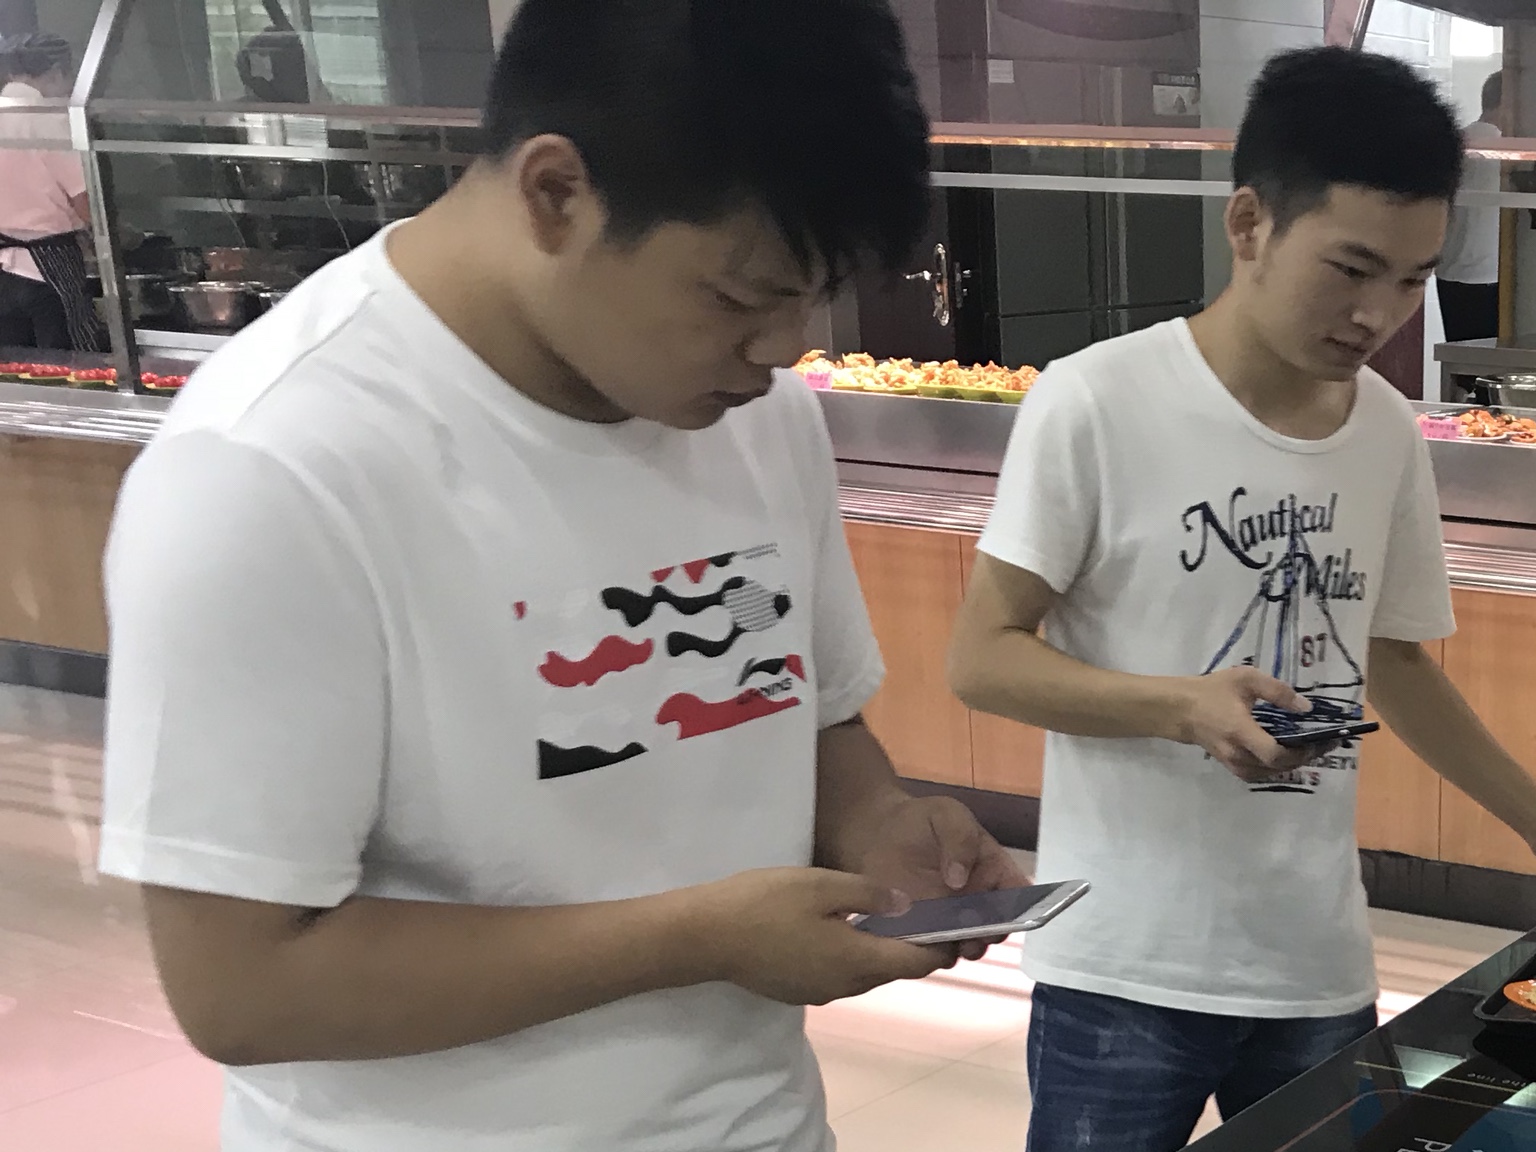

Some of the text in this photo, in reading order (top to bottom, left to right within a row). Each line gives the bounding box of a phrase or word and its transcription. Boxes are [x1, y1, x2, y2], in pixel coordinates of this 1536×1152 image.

[1181, 486, 1338, 572] Nautical
[1467, 1072, 1496, 1084] line
[1502, 1079, 1526, 1088] the
